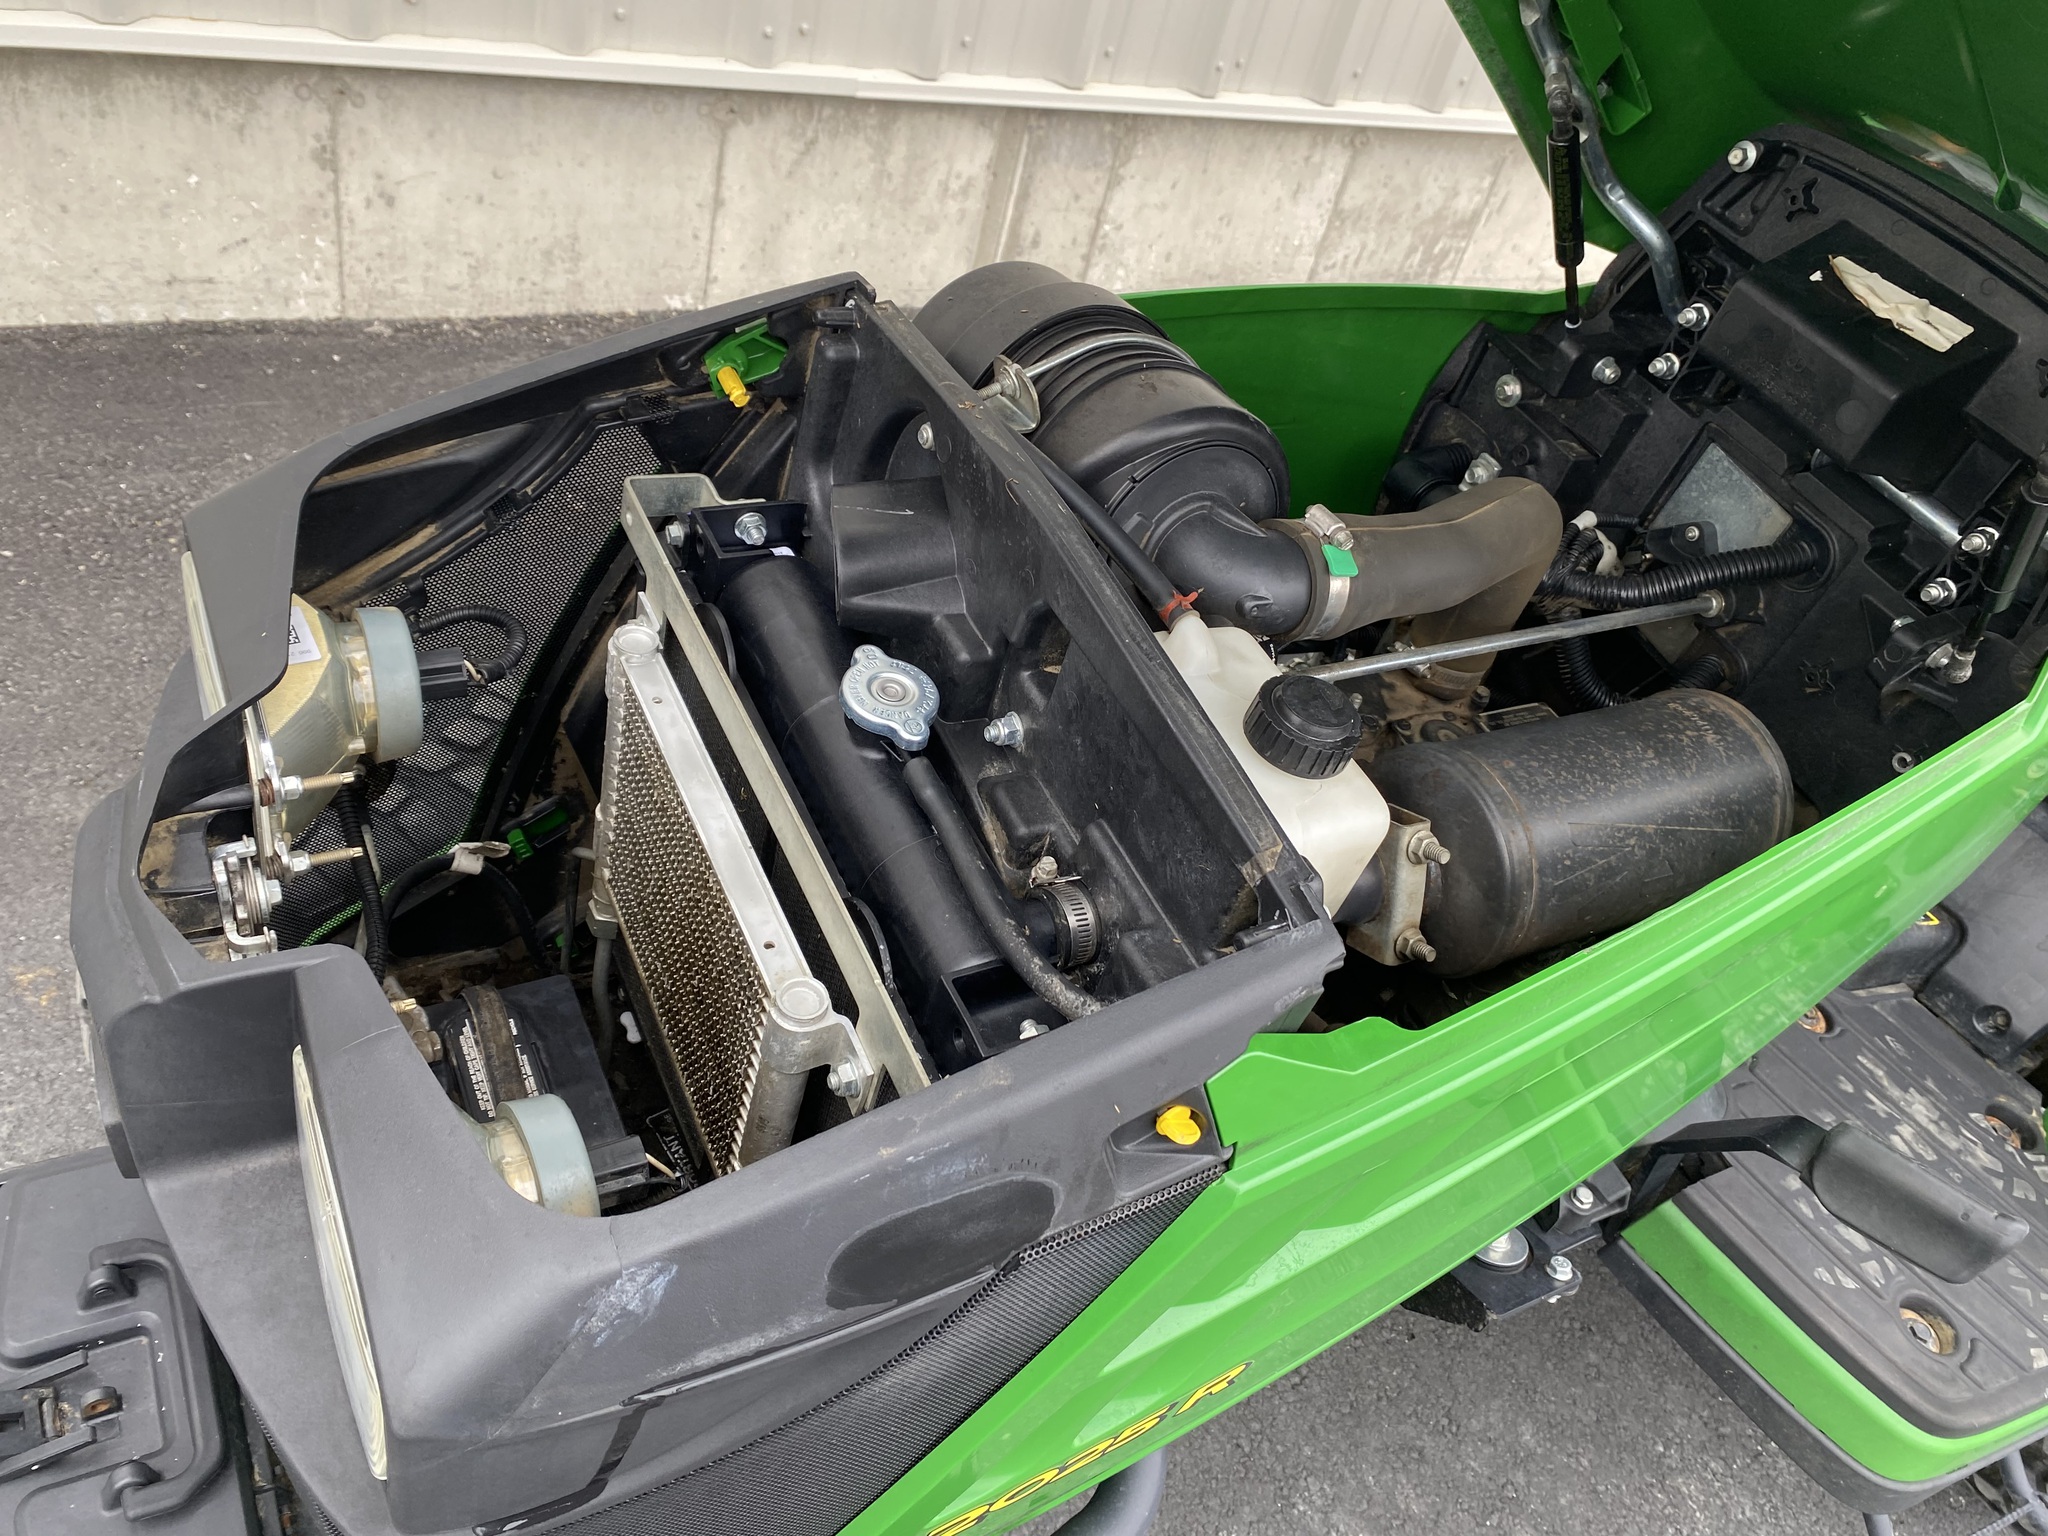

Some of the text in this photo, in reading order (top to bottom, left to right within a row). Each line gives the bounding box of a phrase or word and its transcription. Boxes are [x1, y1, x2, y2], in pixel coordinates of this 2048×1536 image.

[848, 659, 911, 719] DANGER NEVER OPEN HOT
[663, 1134, 698, 1187] ORTANT
[926, 1361, 1254, 1536] 2025R
